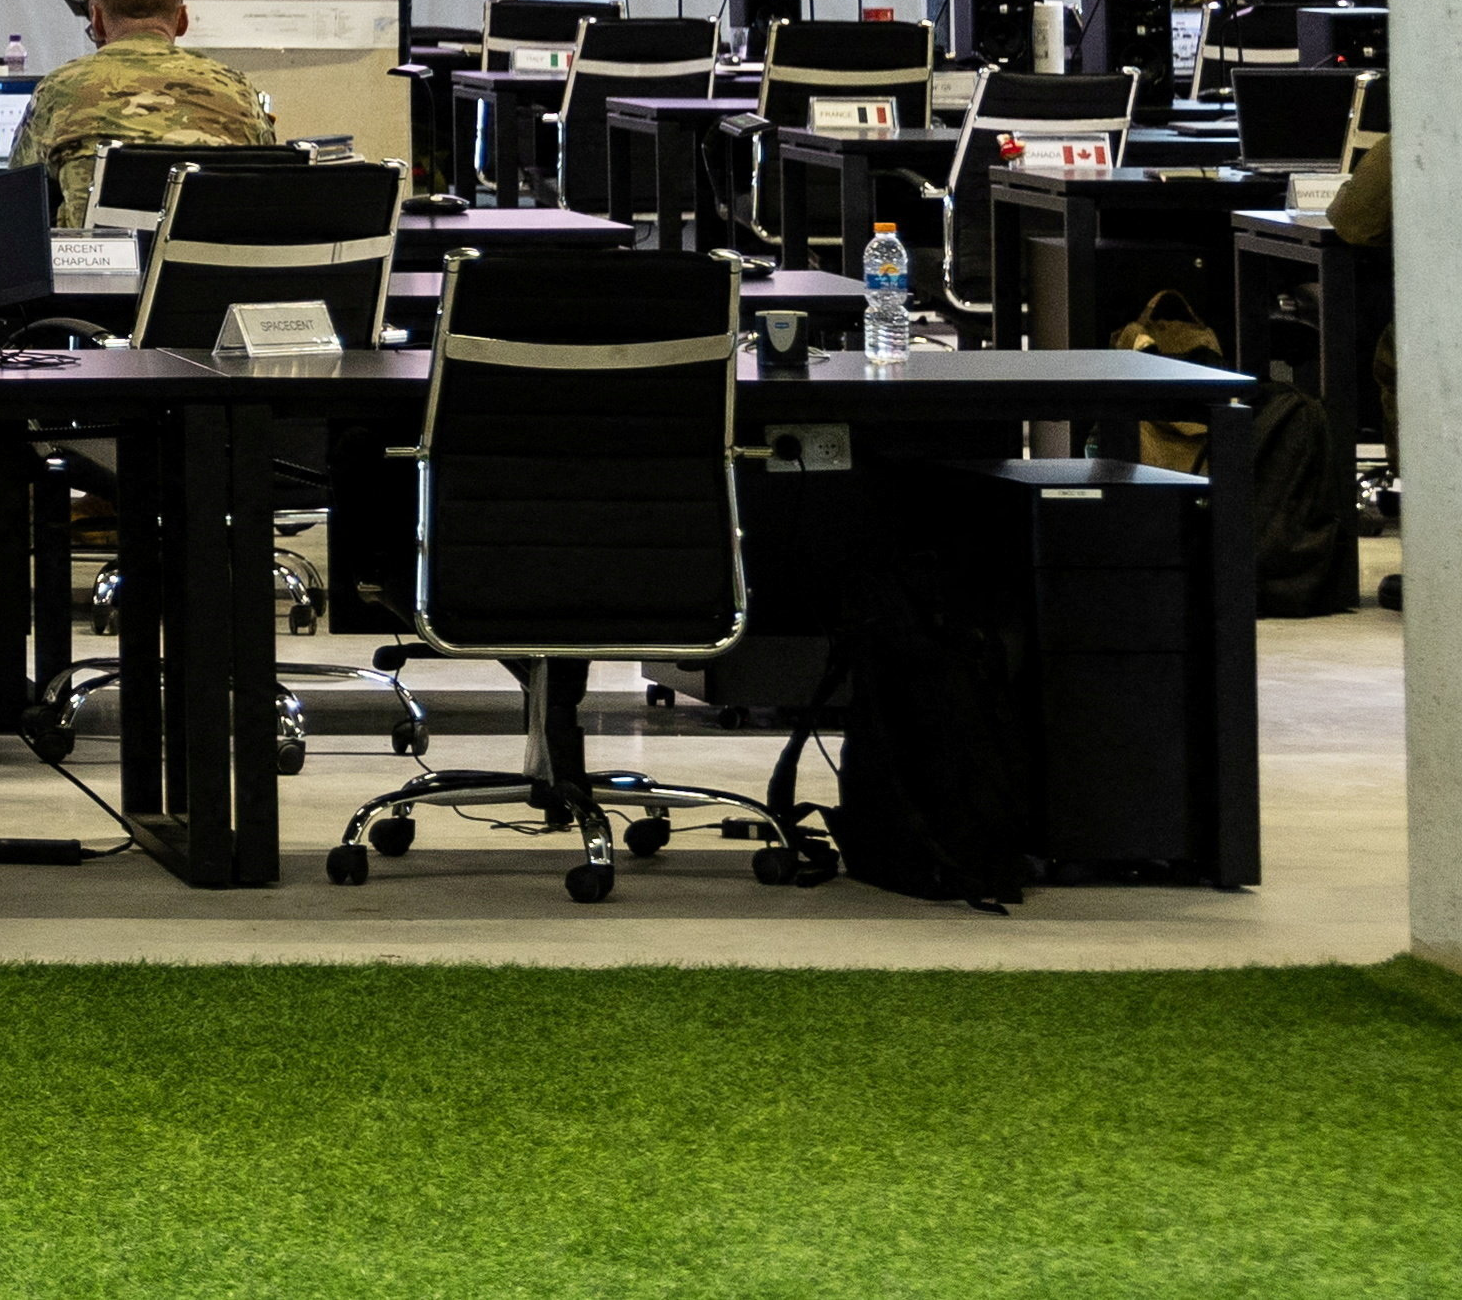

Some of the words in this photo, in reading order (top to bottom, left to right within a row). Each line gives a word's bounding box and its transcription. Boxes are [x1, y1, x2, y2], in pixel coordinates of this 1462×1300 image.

[819, 110, 852, 119] FRANCE
[1296, 189, 1335, 199] SWITZE
[57, 243, 104, 254] ARCENT
[52, 256, 111, 267] CHAPLAIN
[259, 319, 314, 332] SPACECENT
